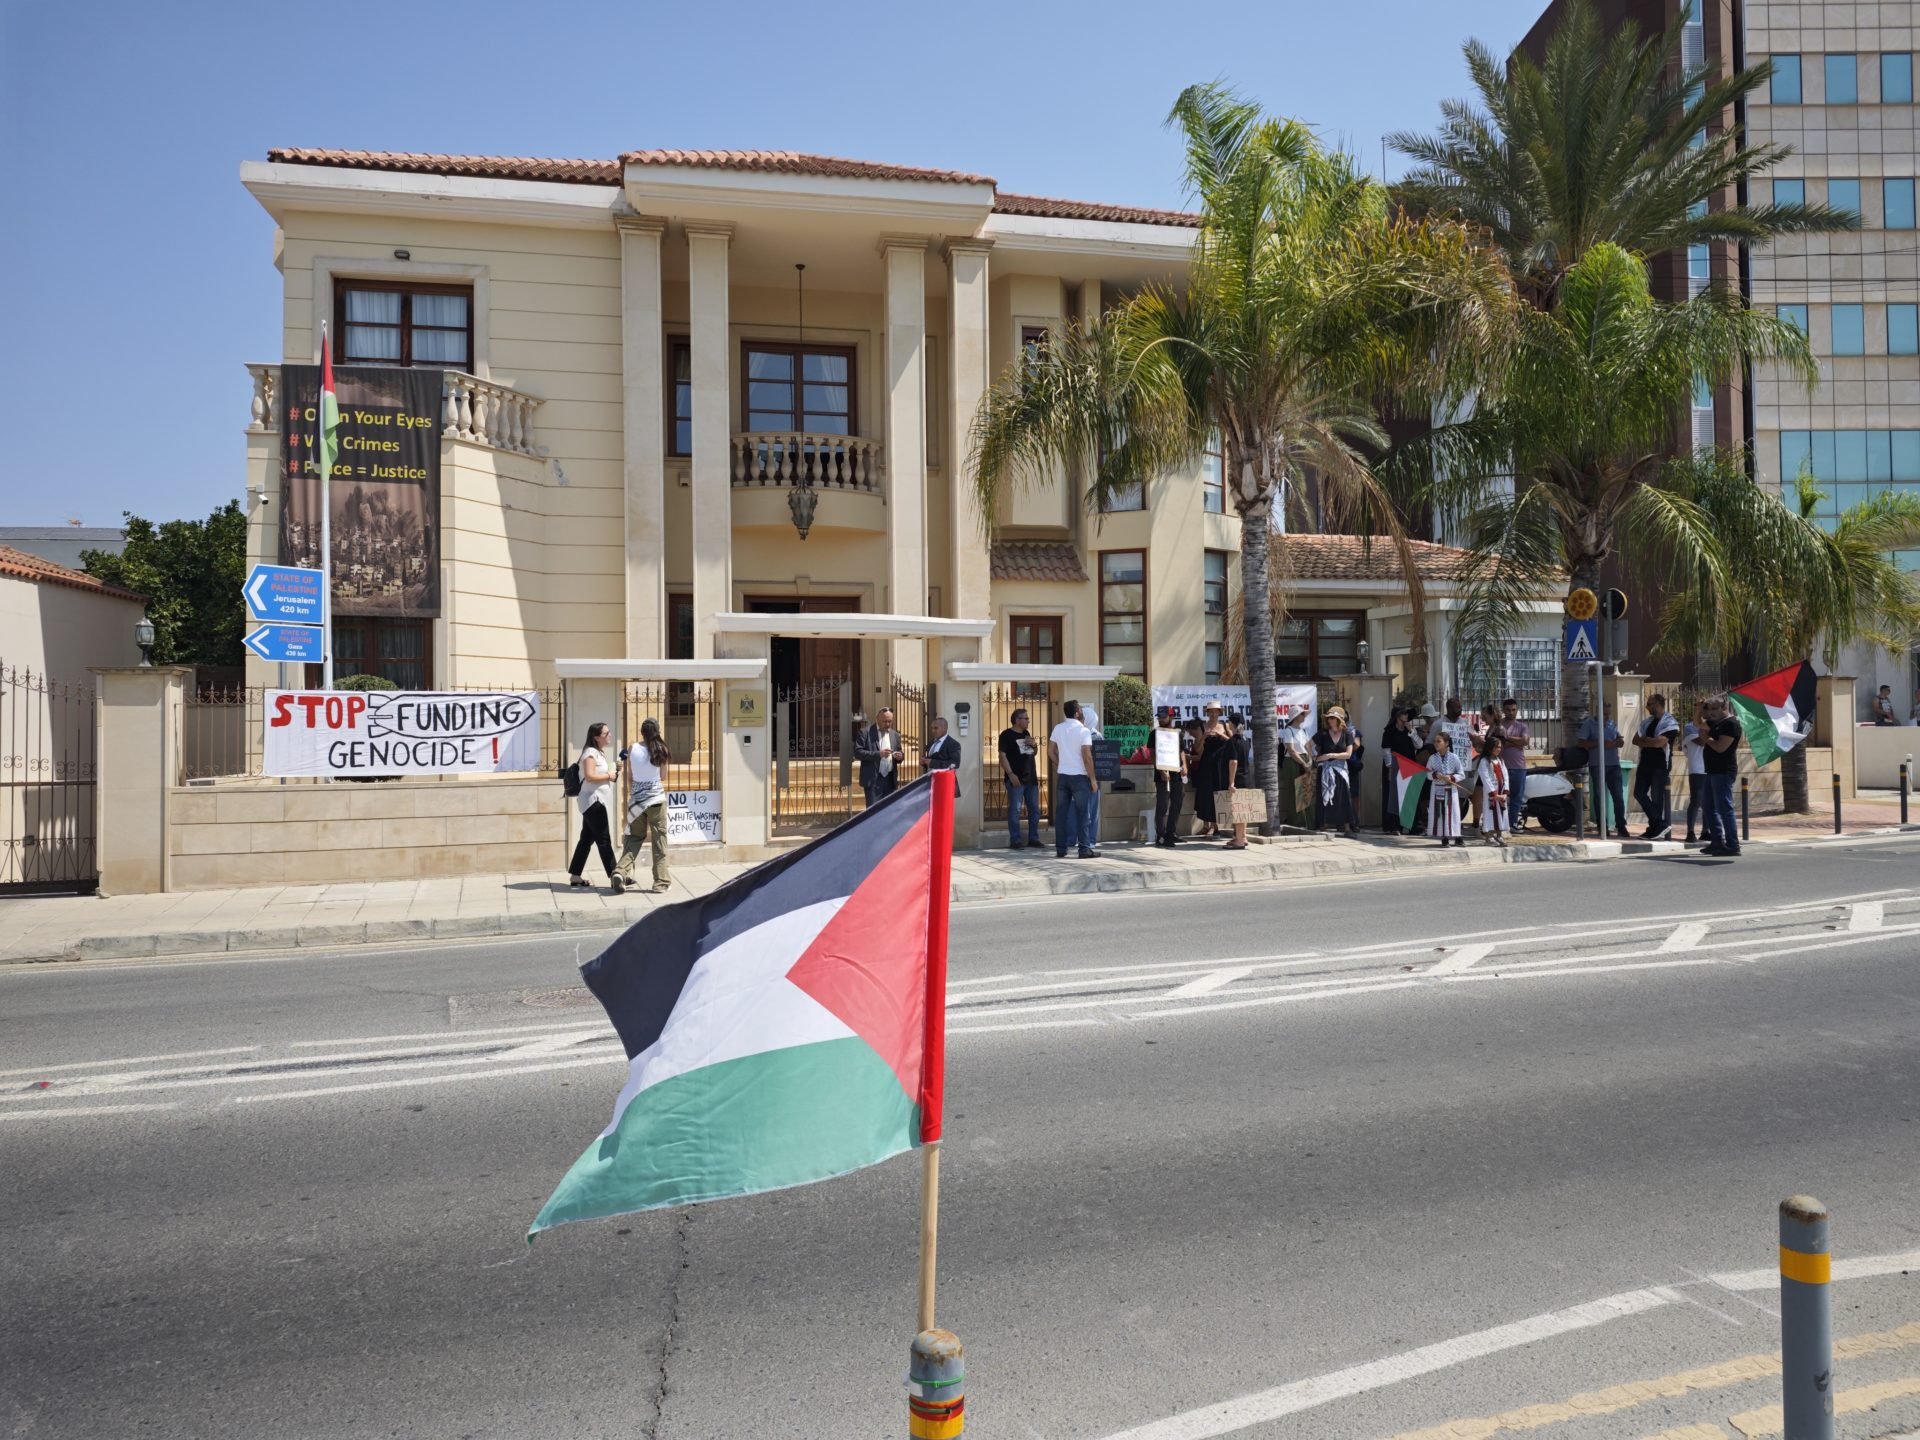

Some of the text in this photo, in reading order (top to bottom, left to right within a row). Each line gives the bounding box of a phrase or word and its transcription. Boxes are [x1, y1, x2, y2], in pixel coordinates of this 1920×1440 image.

[304, 408, 349, 424] On
[354, 410, 392, 426] Your
[396, 413, 432, 430] Eyes
[343, 436, 400, 452] Crimes
[371, 463, 427, 479] Justice
[272, 573, 300, 583] STATE
[271, 583, 318, 595] PALESTINE
[273, 594, 316, 605] Jerusalem
[280, 605, 310, 615] 420 km
[271, 694, 521, 732] STOP FUNDING
[328, 738, 477, 769] GENOCIDE
[668, 792, 687, 806] NO
